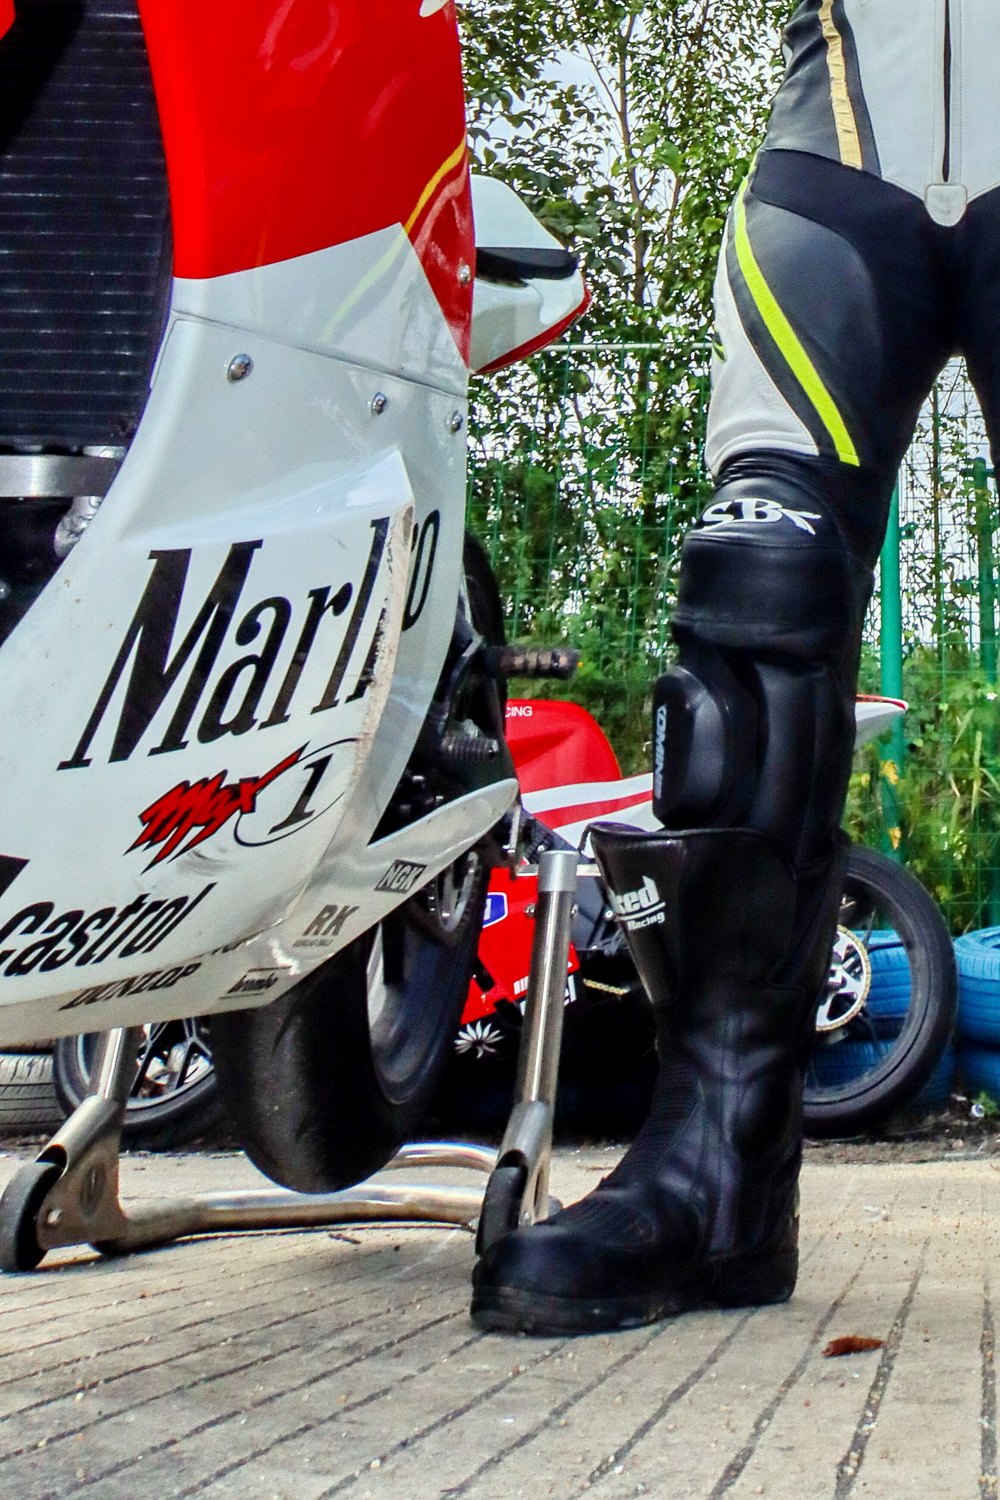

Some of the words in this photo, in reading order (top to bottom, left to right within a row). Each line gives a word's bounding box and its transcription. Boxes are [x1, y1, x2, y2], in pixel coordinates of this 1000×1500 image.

[375, 861, 426, 892] NGK
[0, 881, 218, 978] Castrol
[301, 904, 361, 937] RK
[57, 961, 202, 1011] DUNLOP
